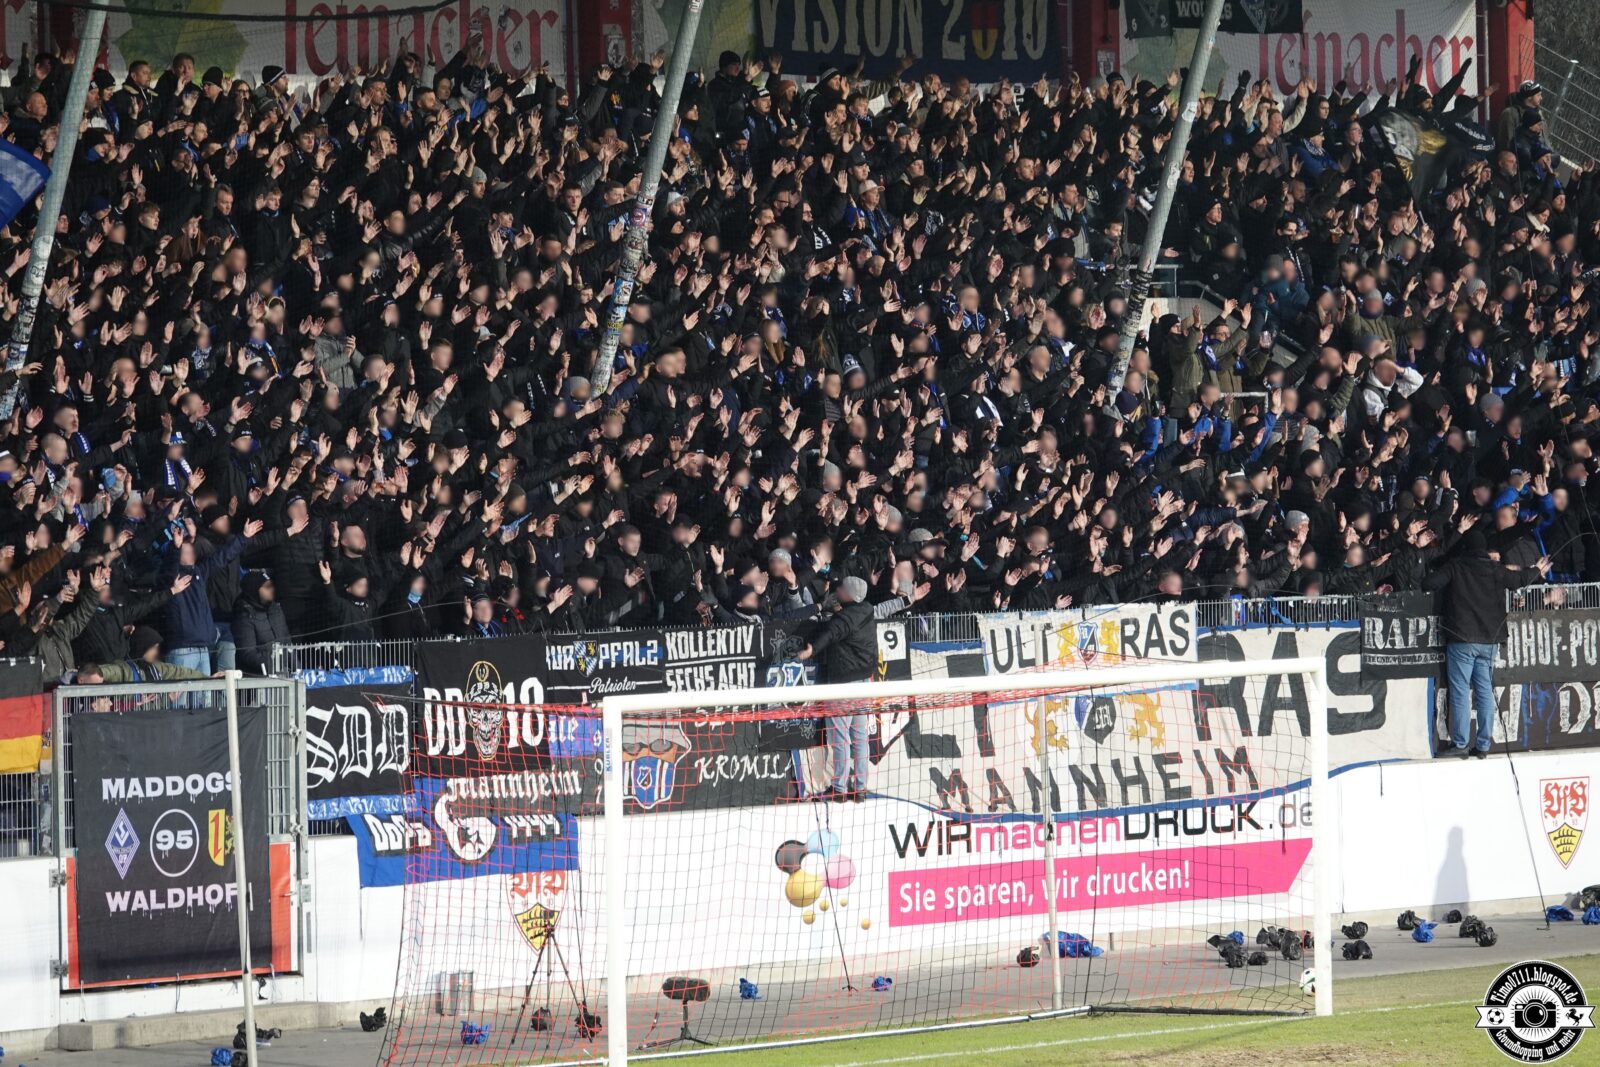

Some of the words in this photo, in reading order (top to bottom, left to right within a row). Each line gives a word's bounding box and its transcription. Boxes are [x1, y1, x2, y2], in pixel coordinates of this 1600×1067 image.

[759, 0, 923, 59] VISION
[942, 0, 1048, 60] 2010
[665, 625, 754, 660] KOLLEKTIV
[883, 630, 898, 650] 9
[1120, 610, 1191, 660] RAS
[589, 677, 637, 694] Patrioten
[423, 687, 467, 757] DD
[504, 676, 545, 748] 10
[929, 745, 1260, 814] MANNHEIM
[156, 829, 194, 853] 95
[105, 882, 239, 913] WALDHOF
[899, 882, 937, 913] Sie
[944, 879, 1034, 916] sparen,
[1041, 869, 1079, 900] wir
[1086, 860, 1190, 897] drucken!
